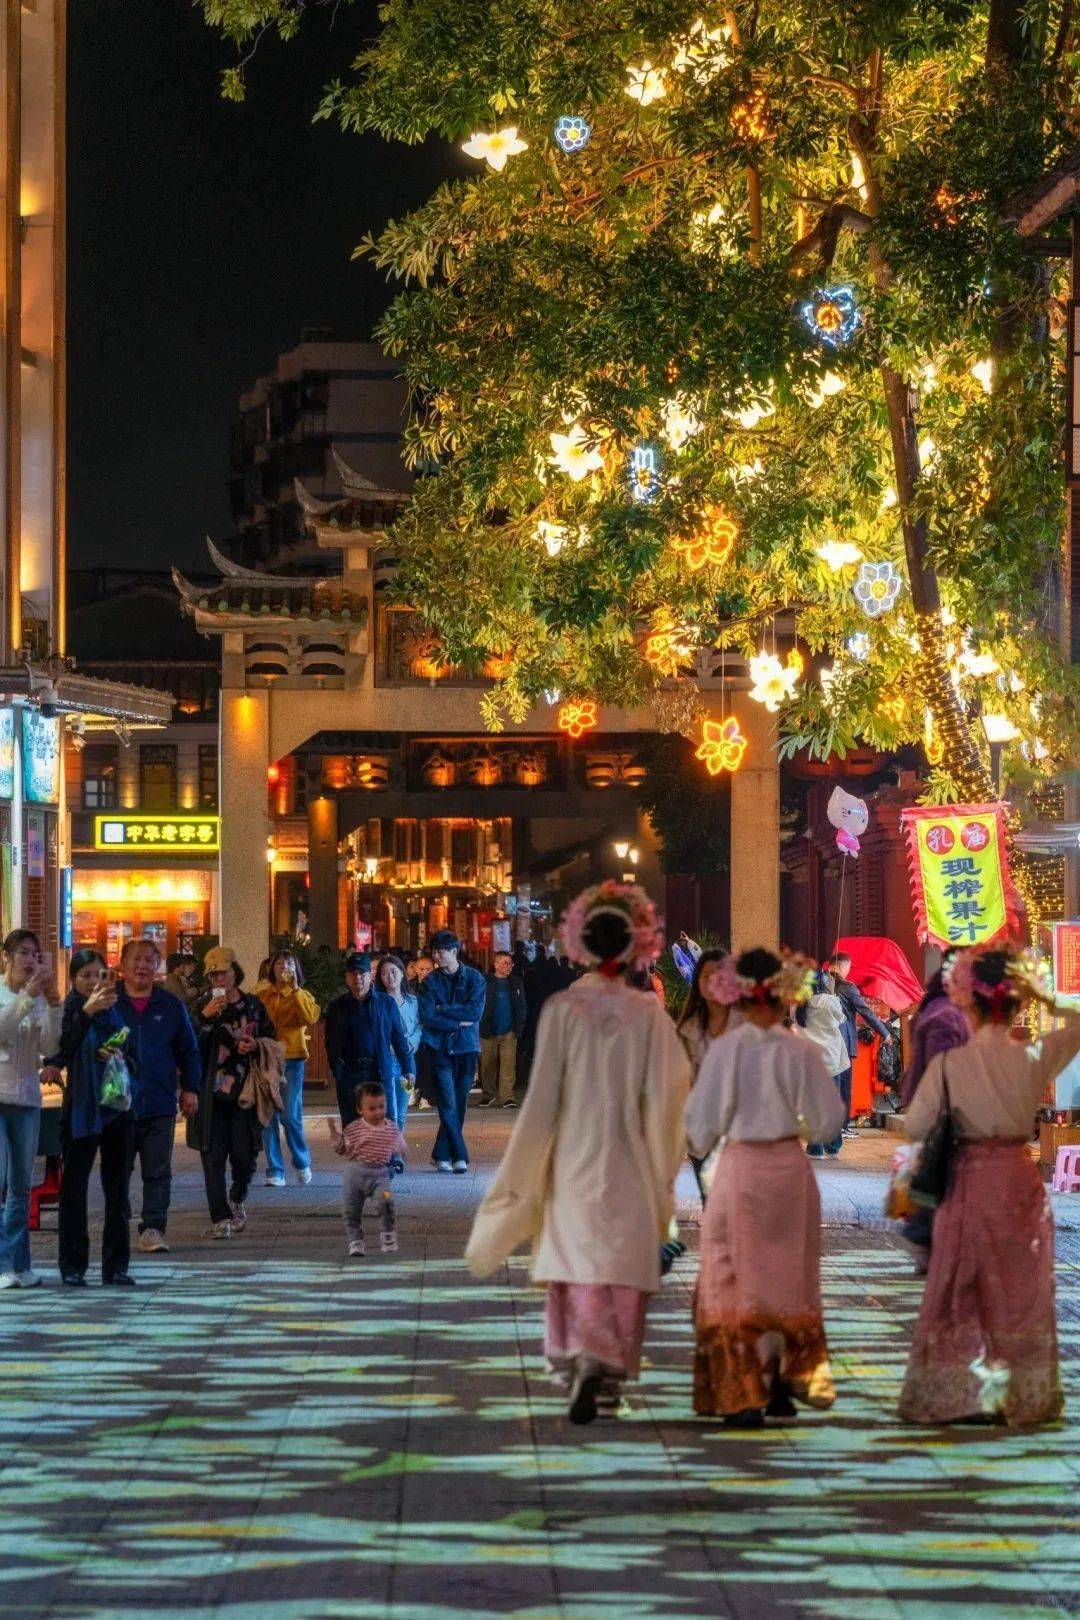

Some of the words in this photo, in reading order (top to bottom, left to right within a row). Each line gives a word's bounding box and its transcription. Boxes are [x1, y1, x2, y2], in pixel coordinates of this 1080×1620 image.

[126, 824, 214, 843] 中华老字号
[941, 857, 988, 941] 现榨果汁
